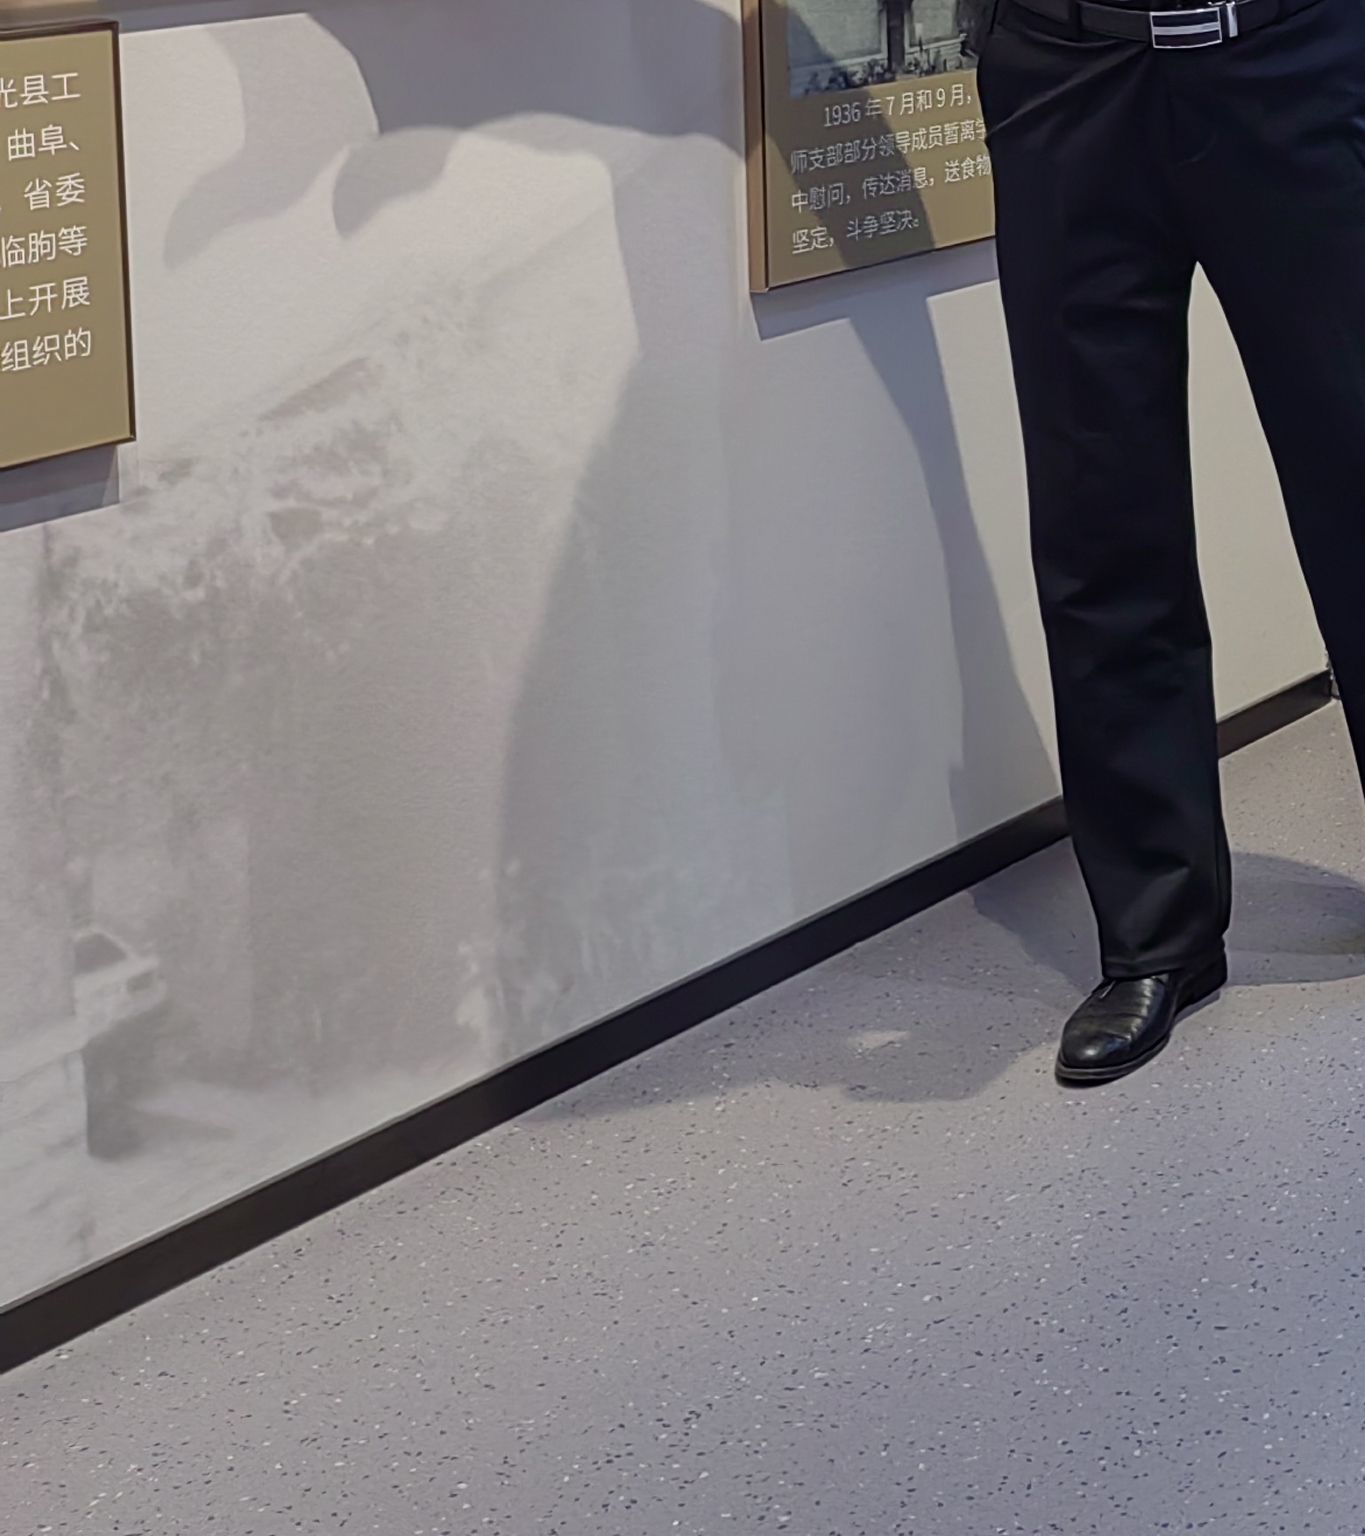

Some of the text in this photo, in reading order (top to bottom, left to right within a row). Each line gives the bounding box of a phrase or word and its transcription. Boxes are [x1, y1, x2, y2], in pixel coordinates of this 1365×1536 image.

[0, 72, 80, 109] 光县工
[8, 123, 80, 162] 曲阜、
[0, 225, 87, 267] 临朐等
[0, 275, 91, 321] 上开展
[1, 327, 92, 372] 组织的
